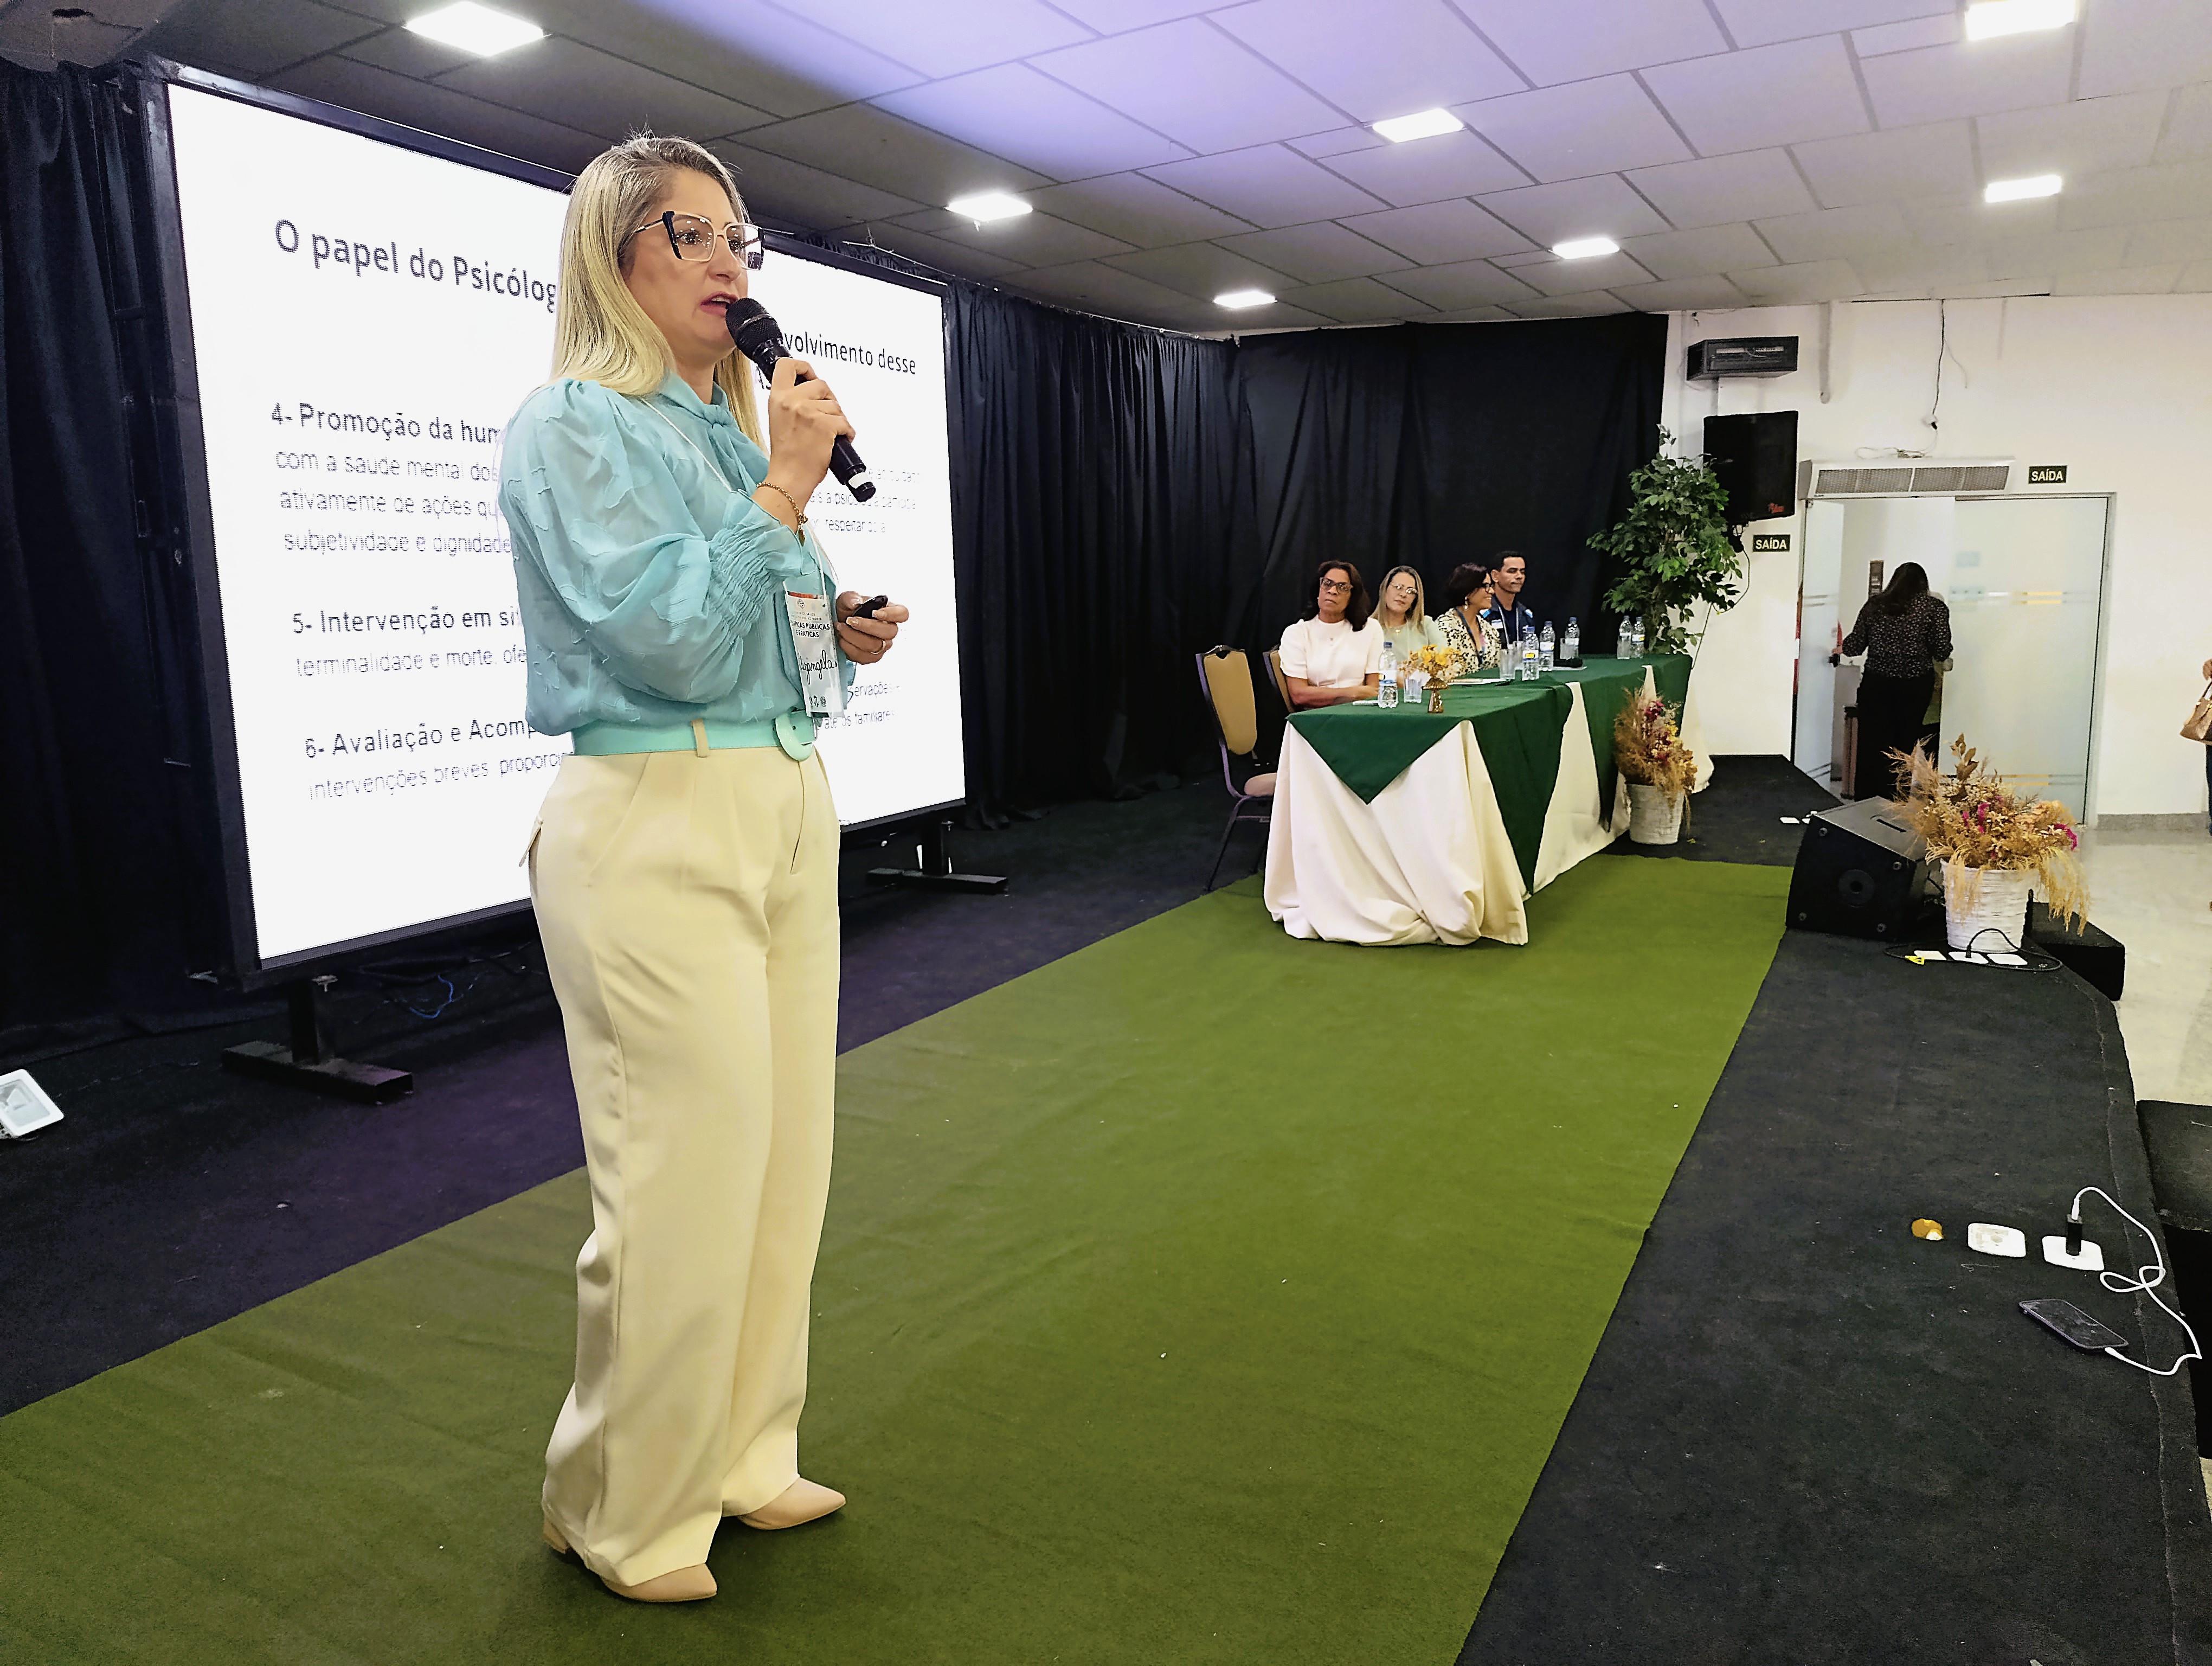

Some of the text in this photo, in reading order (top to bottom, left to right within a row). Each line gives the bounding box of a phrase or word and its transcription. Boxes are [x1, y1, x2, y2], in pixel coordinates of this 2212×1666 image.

[274, 219, 299, 253] O
[312, 234, 398, 277] papel
[409, 248, 444, 281] do
[878, 348, 915, 375] desse
[272, 402, 293, 425] 4-
[299, 403, 420, 441] Promoção
[429, 417, 453, 440] da
[276, 452, 318, 469] com
[327, 456, 337, 472] a
[408, 462, 464, 479] mental
[2031, 468, 2063, 481] SAÍDA
[280, 489, 385, 512] ativamente
[394, 496, 414, 513] de
[422, 496, 471, 518] ações
[285, 529, 409, 555] subjetividade
[416, 537, 427, 552] e
[1756, 537, 1787, 549] SAÍDA
[293, 613, 312, 633] 5-
[320, 606, 454, 635] Intervenção
[461, 613, 491, 627] em
[297, 653, 422, 676] terminalidade
[430, 654, 440, 668] e
[305, 739, 324, 758] 6-
[332, 723, 442, 755] Avaliação
[451, 728, 461, 741] e
[310, 770, 427, 799] intervenções
[434, 763, 488, 783] breves
